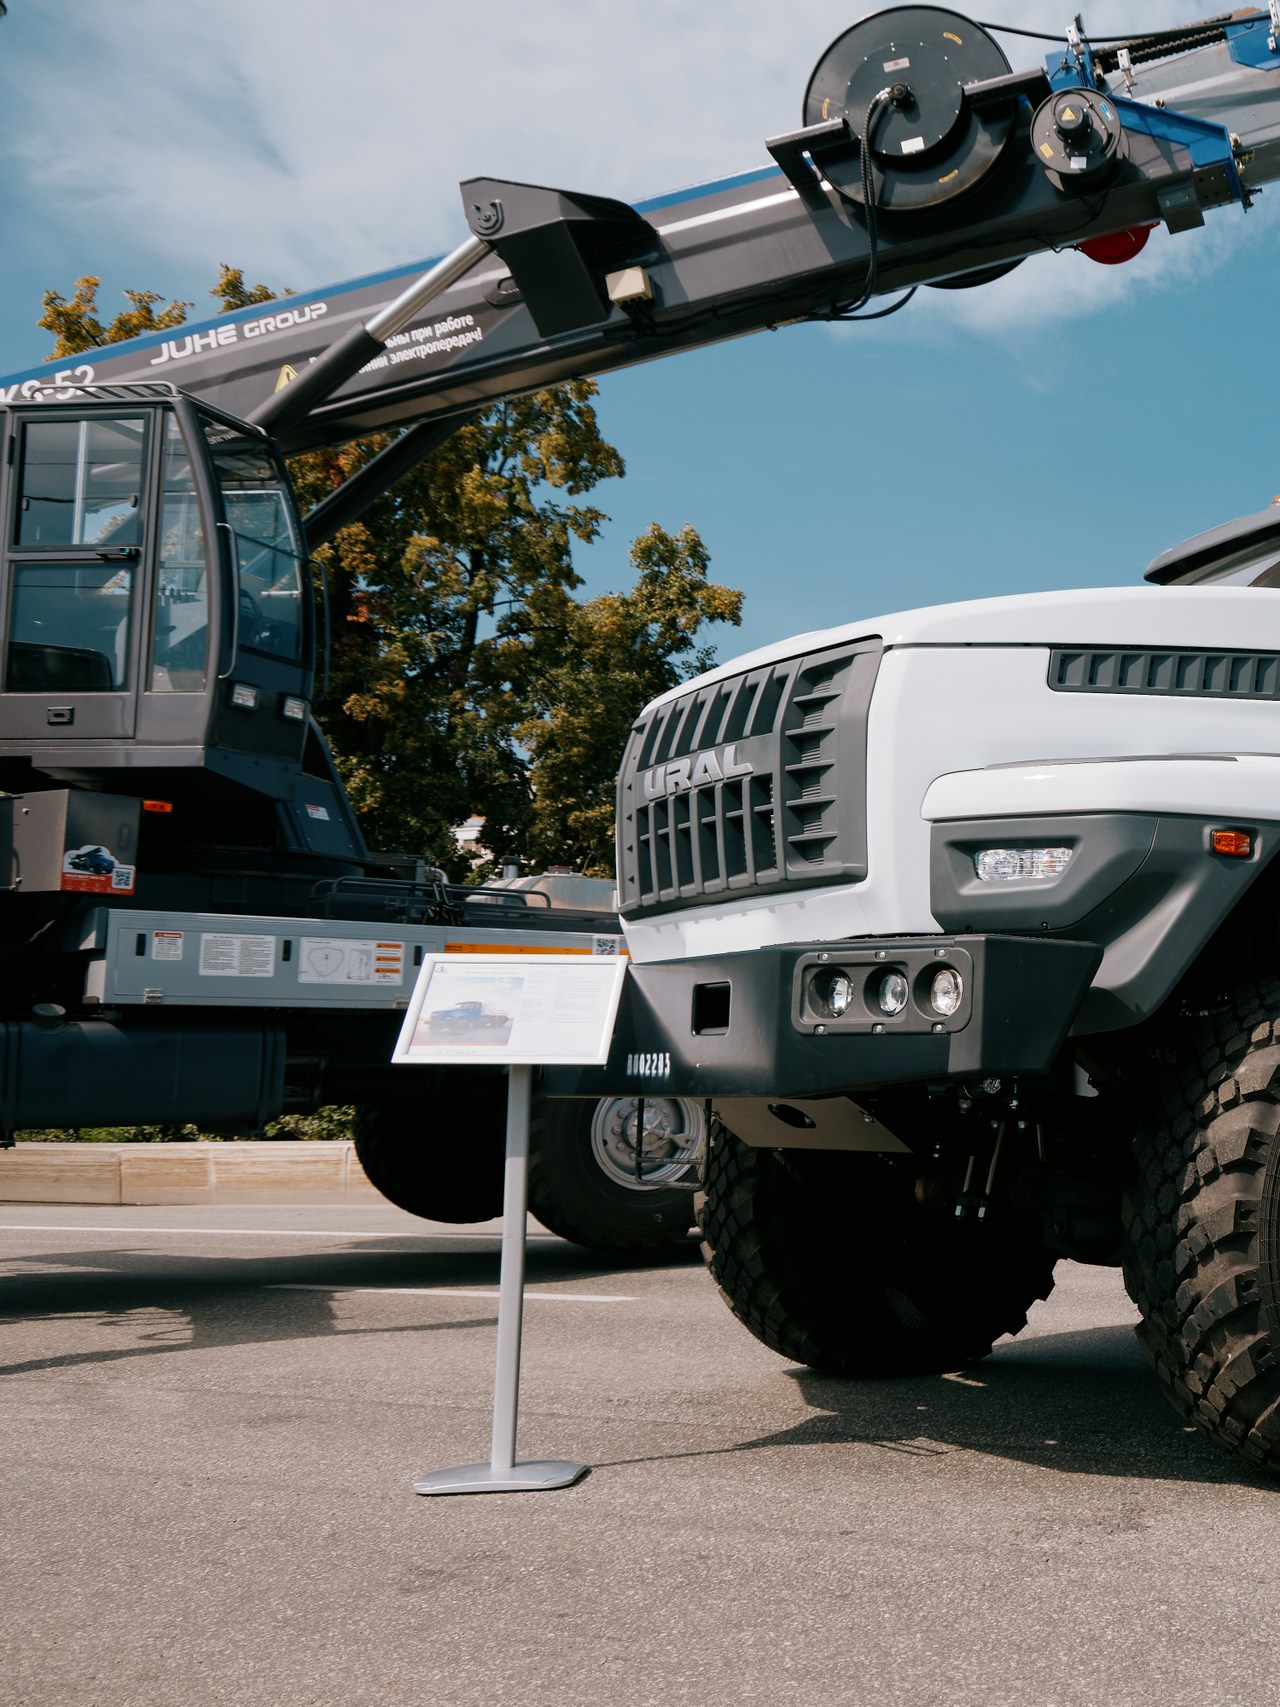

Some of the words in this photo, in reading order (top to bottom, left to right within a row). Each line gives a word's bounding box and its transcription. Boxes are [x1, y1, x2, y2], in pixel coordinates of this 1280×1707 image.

[150, 323, 238, 365] JUHE
[243, 302, 327, 338] GROUP
[389, 326, 483, 366] электропередач!
[411, 325, 433, 342] при
[434, 314, 474, 338] работе
[643, 744, 754, 801] URAL
